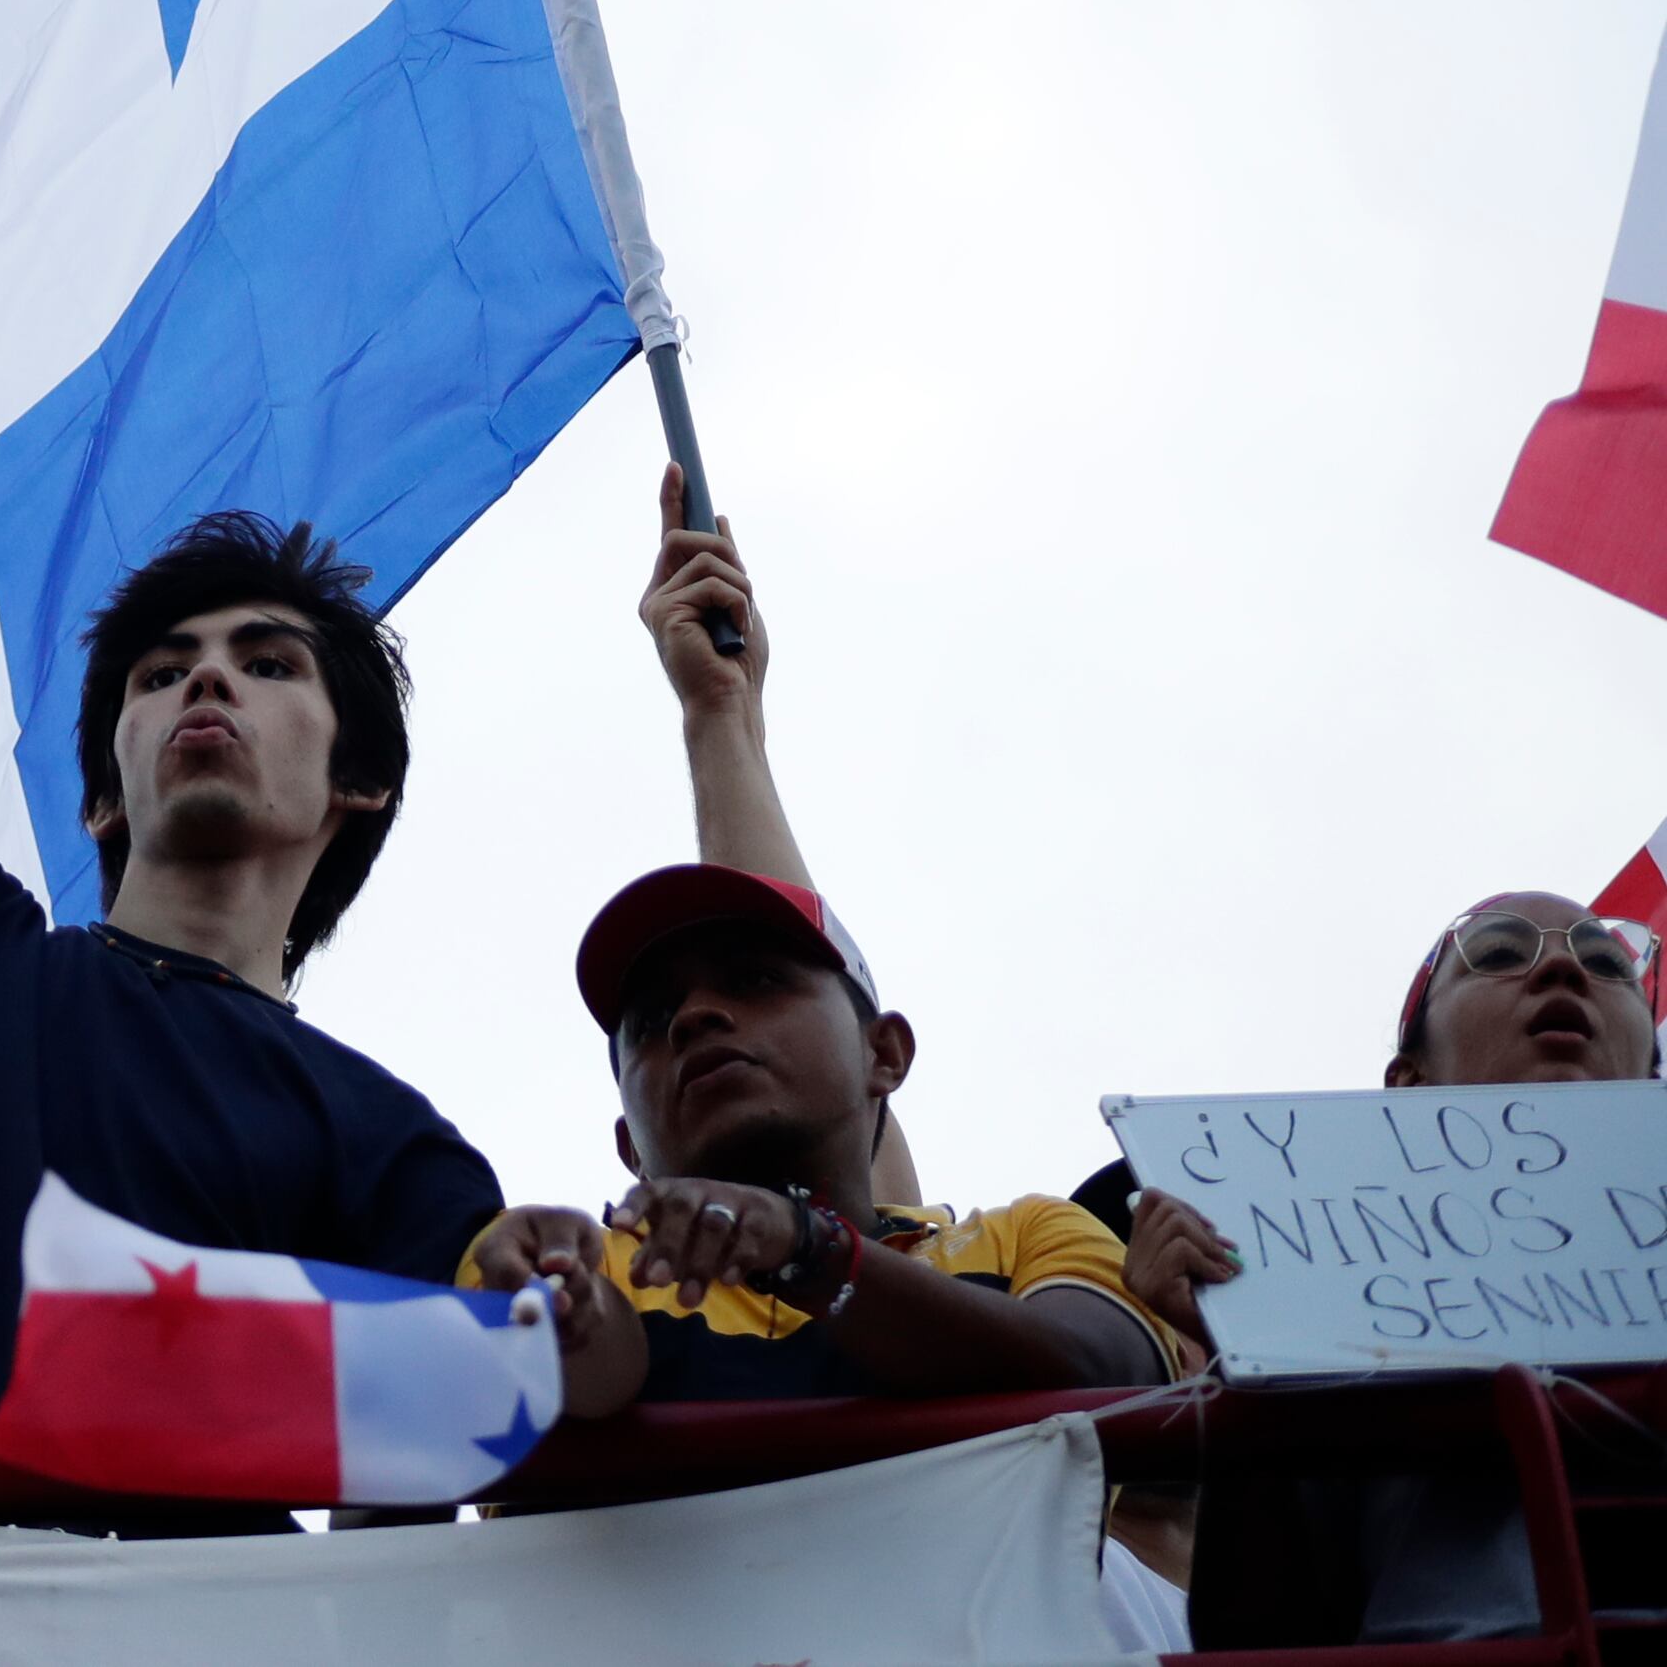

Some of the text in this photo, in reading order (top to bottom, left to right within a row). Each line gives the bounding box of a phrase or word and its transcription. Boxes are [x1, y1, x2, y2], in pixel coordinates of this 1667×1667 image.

[1180, 1101, 1567, 1184] ¿Y LOS
[1249, 1184, 1667, 1268] NIÑOS D
